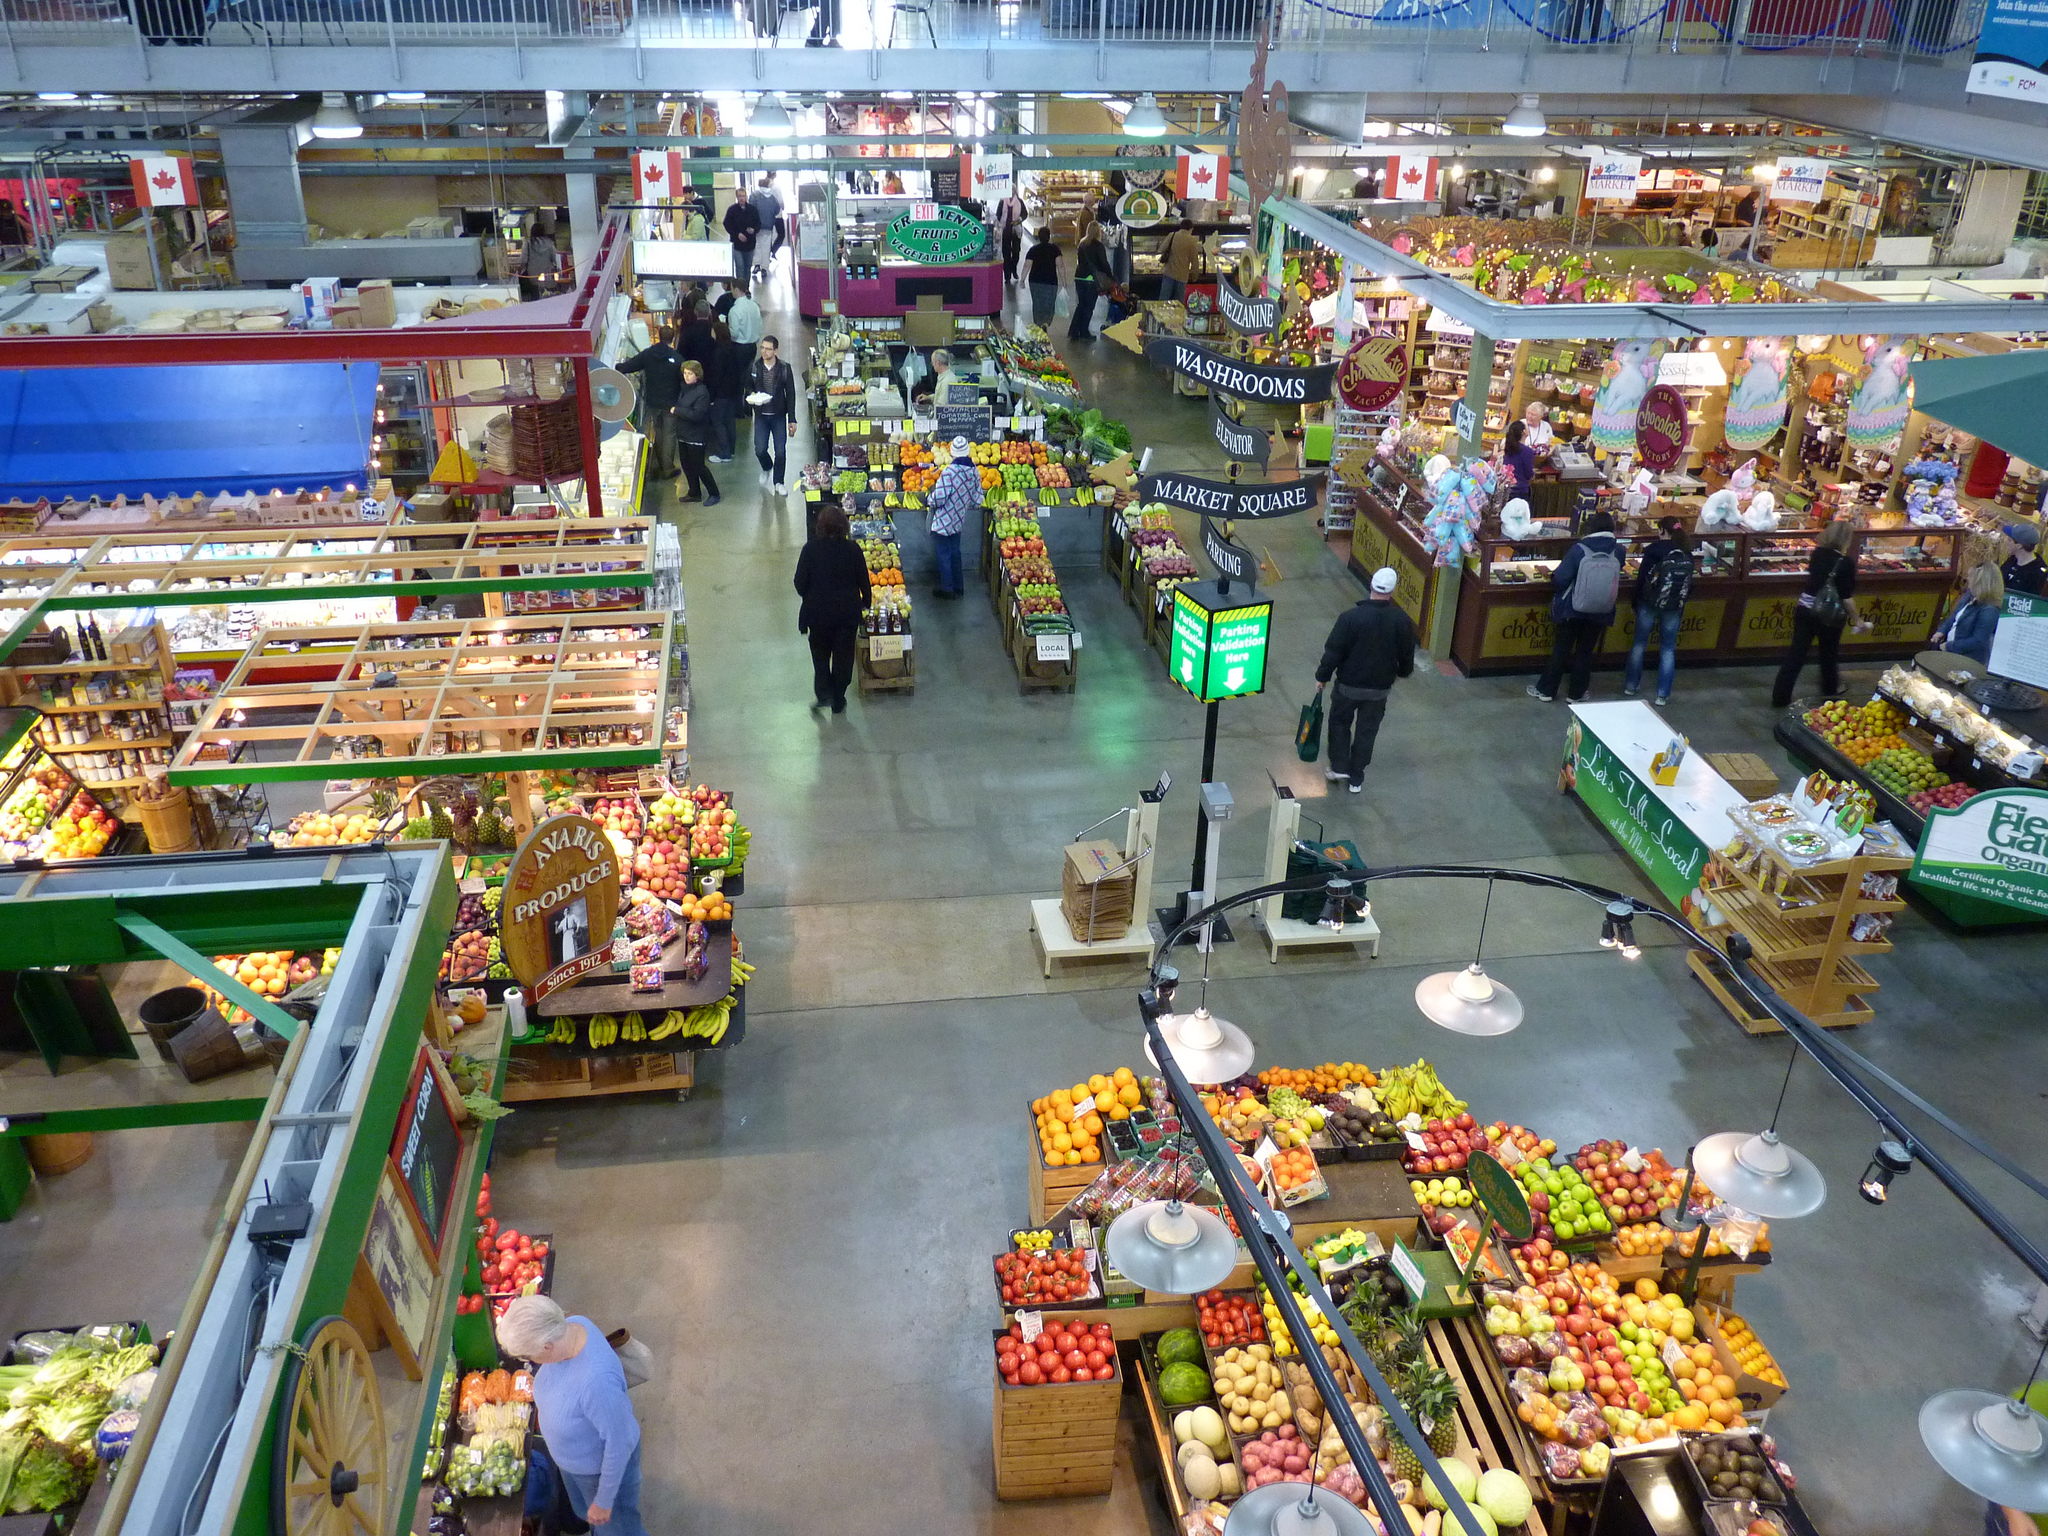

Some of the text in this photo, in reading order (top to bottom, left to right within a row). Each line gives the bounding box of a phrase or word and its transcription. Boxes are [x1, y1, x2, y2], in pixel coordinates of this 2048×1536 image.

[2014, 1, 2028, 12] the
[2018, 79, 2036, 90] FCM
[1589, 179, 1634, 191] MARKET
[1774, 181, 1822, 194] MARKET
[915, 204, 935, 220] EXIT
[913, 228, 959, 240] FRUITS
[891, 238, 957, 263] VEGETABLES
[959, 240, 981, 257] INC.
[931, 242, 940, 252] &
[1218, 284, 1274, 328] MEZZANINE
[1175, 345, 1306, 399] WASHROOMS
[1353, 384, 1396, 405] FACTORY
[1657, 391, 1674, 405] THE
[1215, 418, 1254, 456] ELEVATOR
[1641, 439, 1671, 463] FACTORY
[1154, 479, 1307, 517] MARKET SQUARE
[1205, 532, 1242, 576] PARKING
[1883, 599, 1899, 612] the
[2009, 595, 2033, 609] Field
[1179, 609, 1203, 637] Parking
[1220, 624, 1260, 639] Parking
[1174, 620, 1206, 652] Validation
[1212, 636, 1265, 653] Validation
[1181, 639, 1196, 659] Here
[1225, 652, 1250, 664] Here
[1580, 743, 1615, 793] Let's
[1617, 770, 1648, 832] Talk
[1651, 818, 1699, 880] Local
[1617, 820, 1628, 840] the
[514, 860, 612, 924] PRODUCE
[1919, 869, 1961, 887] healthier
[1962, 880, 1979, 892] life
[1980, 886, 2004, 898] style
[2005, 892, 2015, 901] &
[1951, 868, 1995, 885] Certified
[1996, 879, 2035, 896] Organic
[547, 953, 602, 991] Since 1912
[401, 1066, 434, 1179] SWEET CORN
